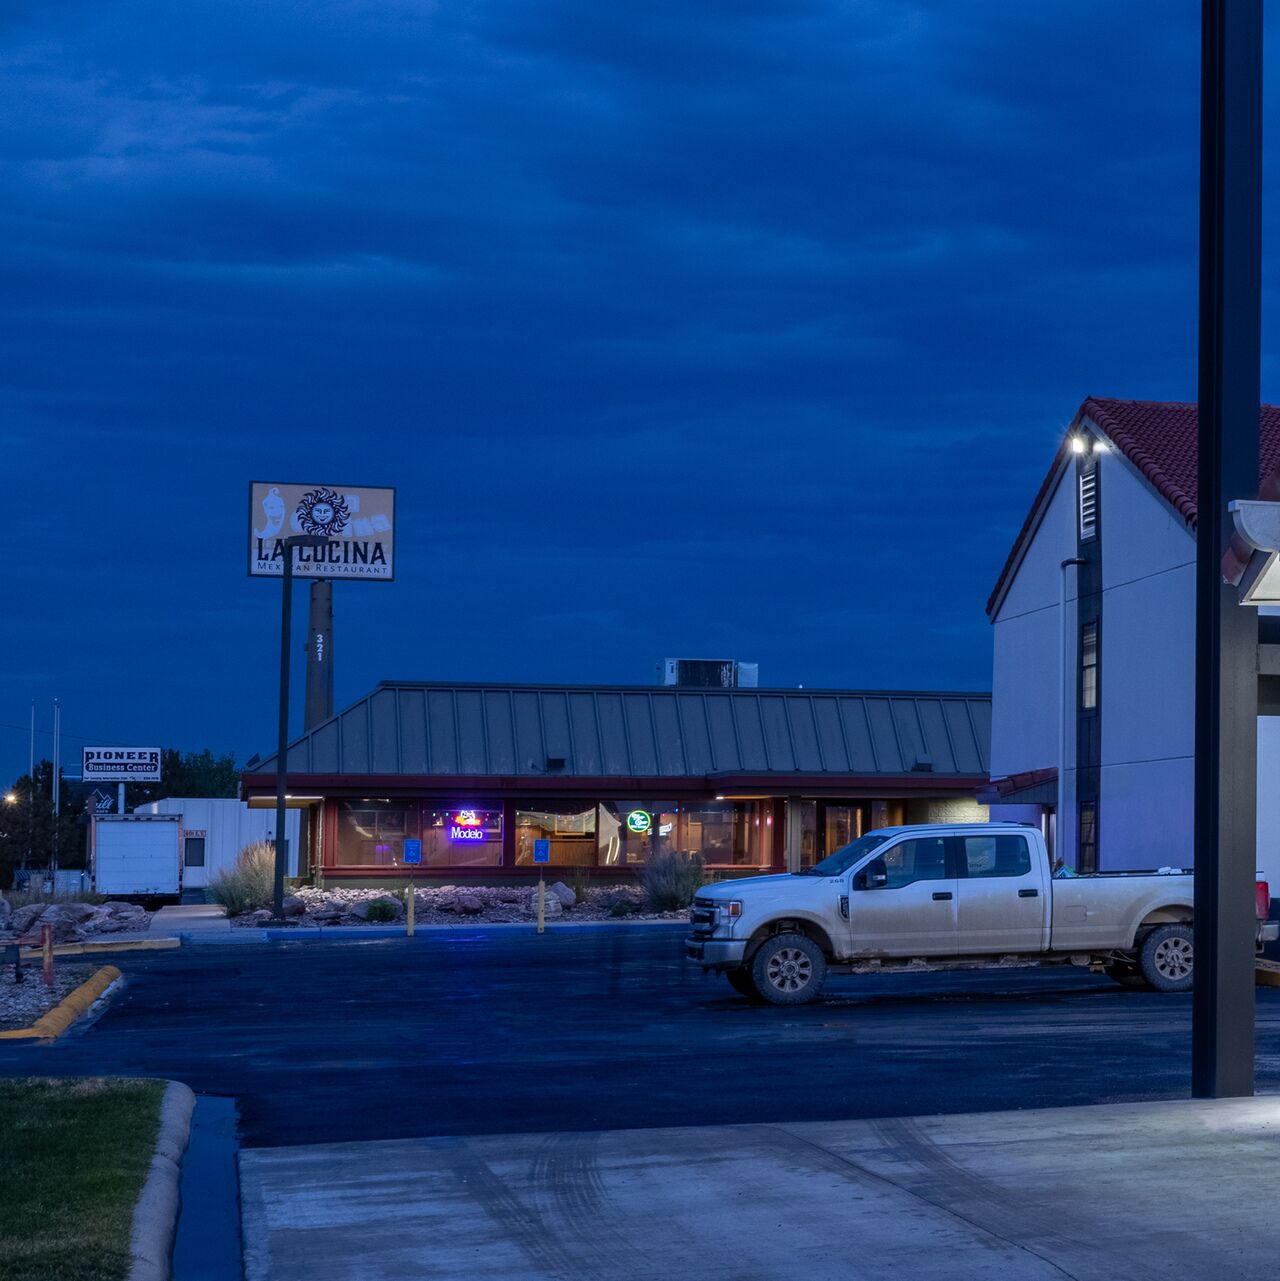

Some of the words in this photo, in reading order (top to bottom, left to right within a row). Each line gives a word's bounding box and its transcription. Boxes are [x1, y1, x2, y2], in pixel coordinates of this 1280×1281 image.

[257, 538, 287, 562] LA
[299, 540, 387, 565] COCINA
[257, 562, 310, 572] MEXAN
[85, 751, 159, 764] PIONEER
[88, 763, 125, 771] Business
[127, 763, 156, 771] Center
[451, 826, 483, 839] Modelo
